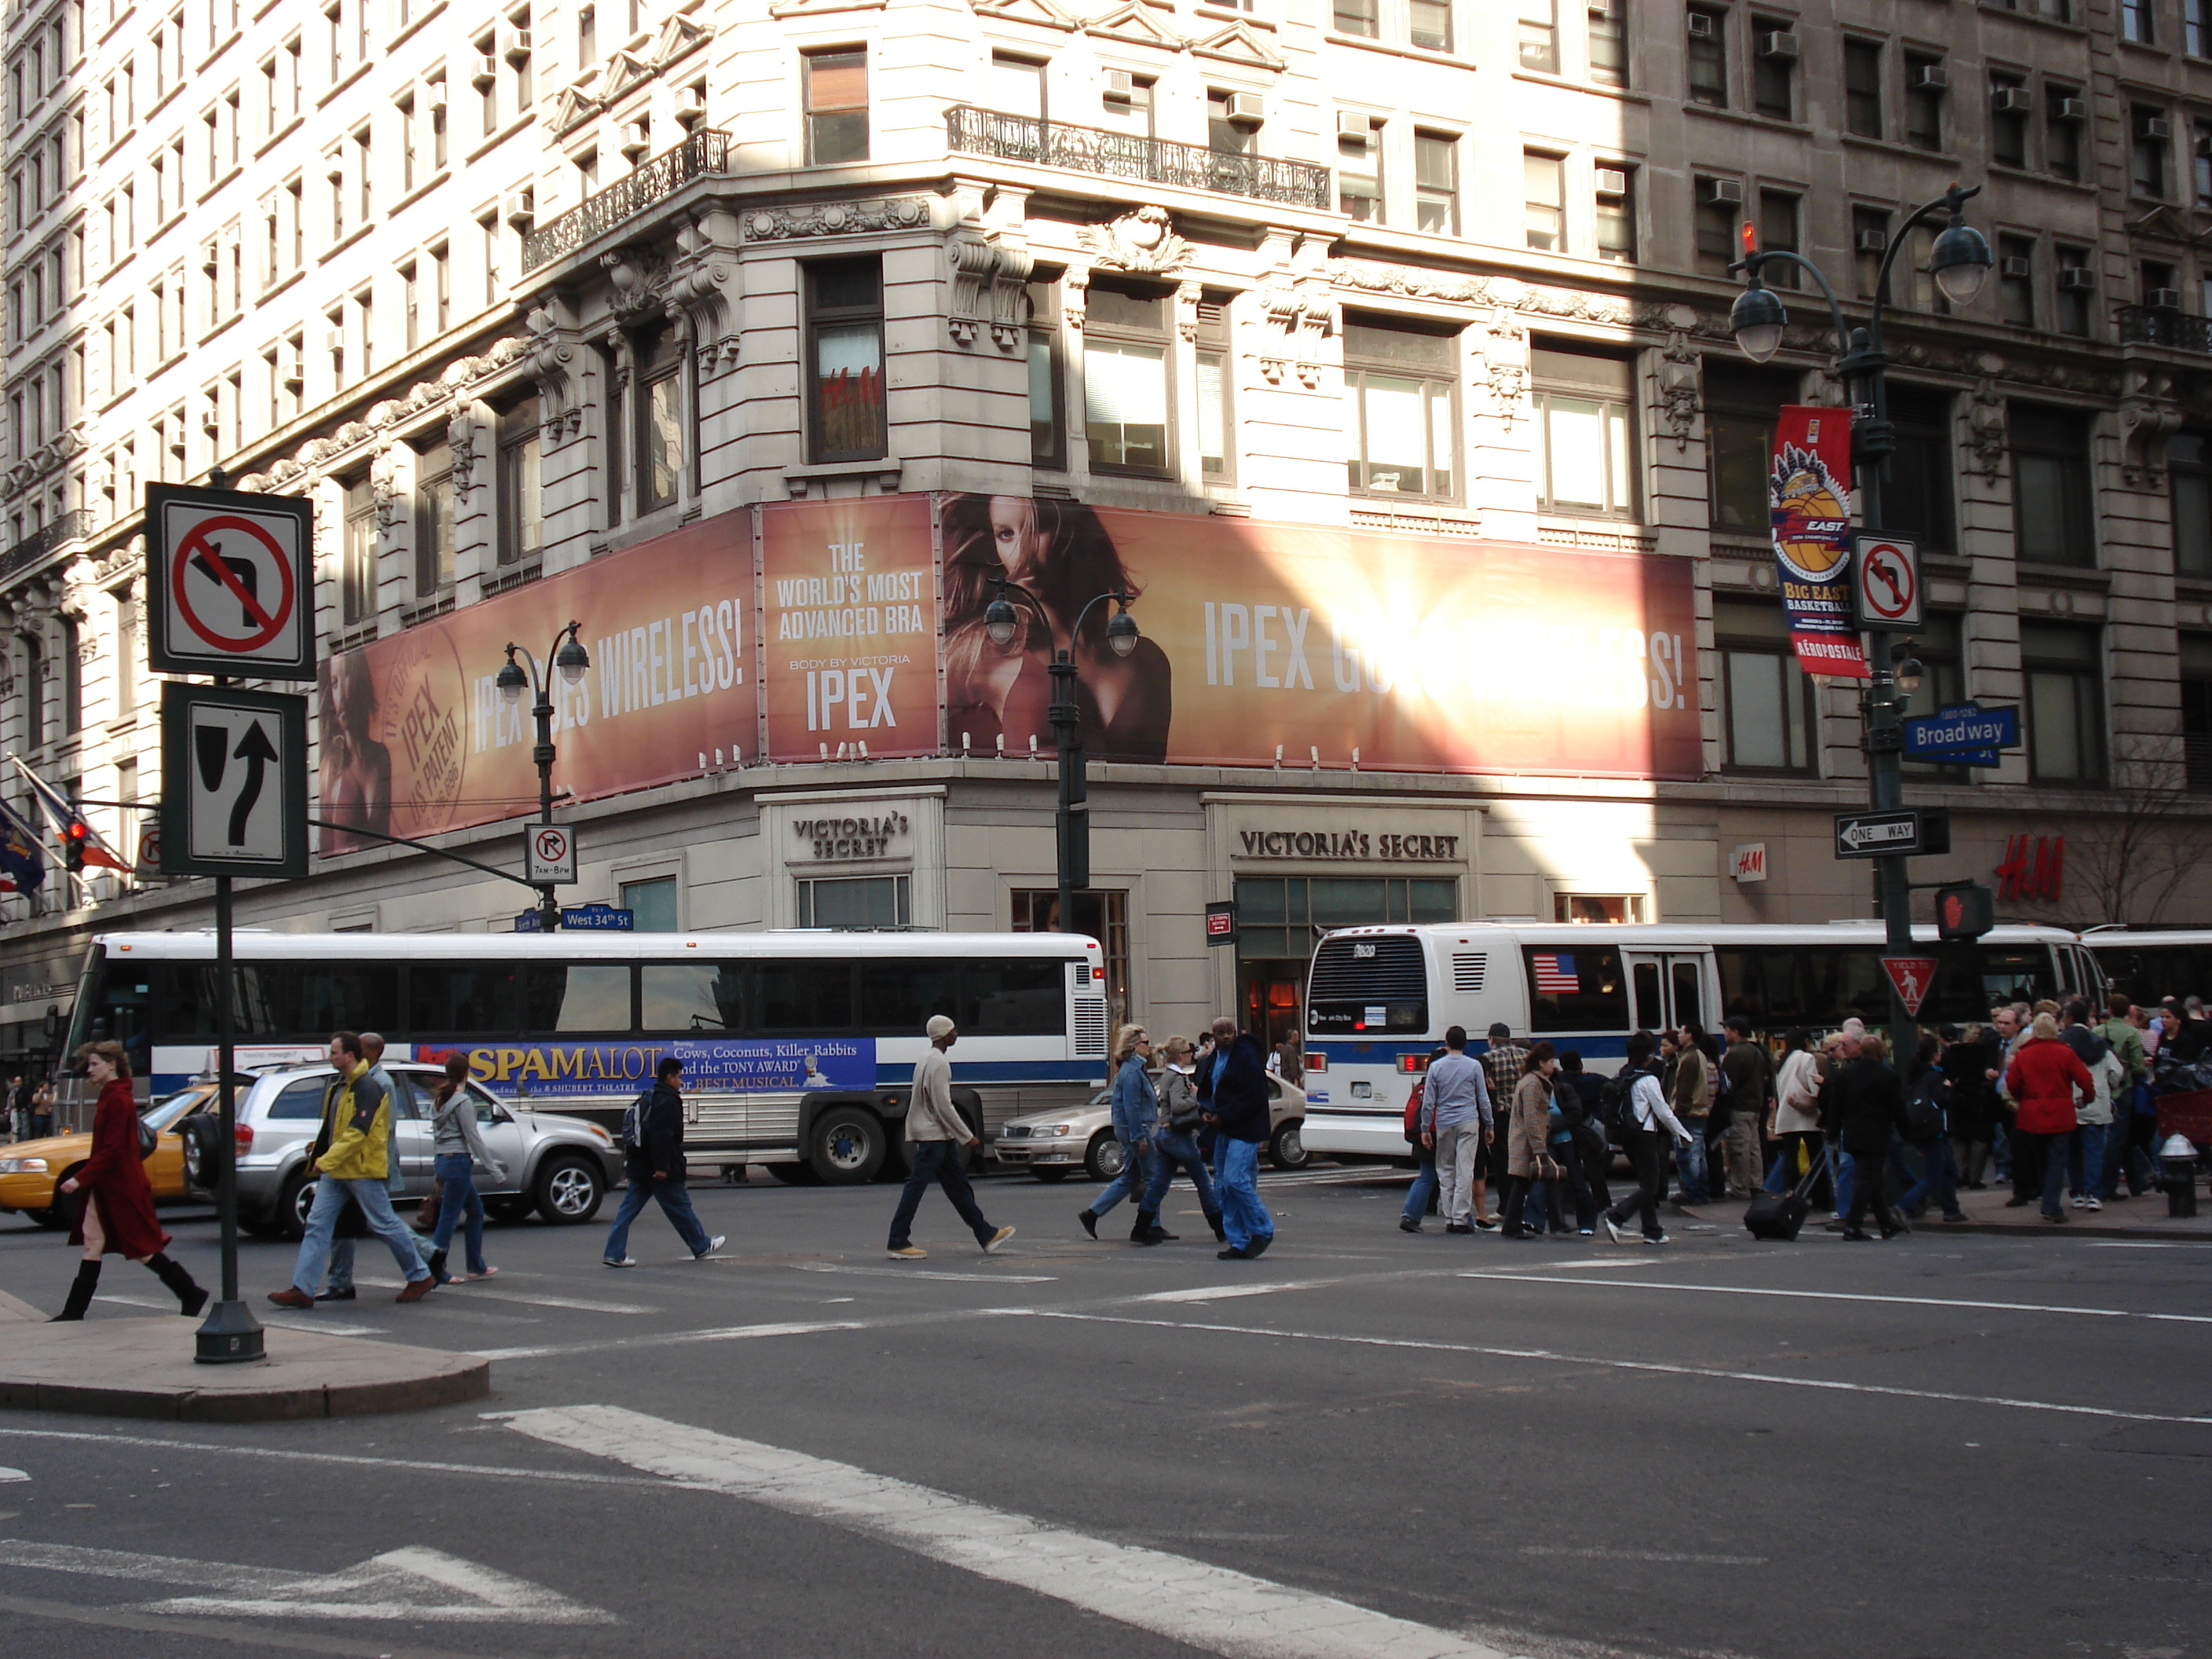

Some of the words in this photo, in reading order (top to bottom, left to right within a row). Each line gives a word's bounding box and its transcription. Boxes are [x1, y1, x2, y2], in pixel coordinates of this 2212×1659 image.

[1807, 522, 1844, 532] EAST
[828, 543, 864, 573] THE
[777, 574, 861, 607] WORLD'S
[867, 572, 923, 602] MOST
[1783, 581, 1810, 599] BIG
[1811, 584, 1851, 601] EAST
[1787, 599, 1852, 612] BASKETBALL
[779, 607, 878, 640] ADVANCED
[885, 605, 923, 633] BRA
[598, 598, 743, 719] WIRELESS!
[1205, 602, 1314, 690] IPEX
[789, 659, 826, 670] BODY
[830, 657, 848, 668] BY
[850, 655, 910, 667] VICTORIA
[807, 667, 897, 731] IPEX
[401, 672, 441, 773] IPEX
[1917, 721, 2003, 746] Broadway
[423, 707, 459, 797] PATENT
[793, 811, 908, 839] VICTORIA'S
[1851, 827, 1873, 841] ONE
[1888, 824, 1911, 838] WAY
[814, 837, 888, 857] SECRET
[1240, 830, 1370, 857] VICTORIA'S
[1379, 834, 1459, 859] SECRET
[1738, 851, 1763, 874] H&M
[1993, 833, 2064, 902] H&M
[567, 914, 591, 925] West
[595, 914, 615, 925] 34th
[617, 915, 628, 925] St
[468, 1046, 664, 1082] SPAMALOT
[674, 1047, 710, 1060] Cows,
[713, 1046, 773, 1058] Coconuts,
[776, 1045, 809, 1057] Killer
[814, 1043, 857, 1056] Rabbits
[681, 1061, 697, 1074] nd
[701, 1060, 720, 1074] the
[723, 1060, 756, 1074] TONY
[552, 1083, 592, 1093] SHUBERT
[596, 1083, 635, 1092] THEATRE
[696, 1078, 728, 1089] BEST
